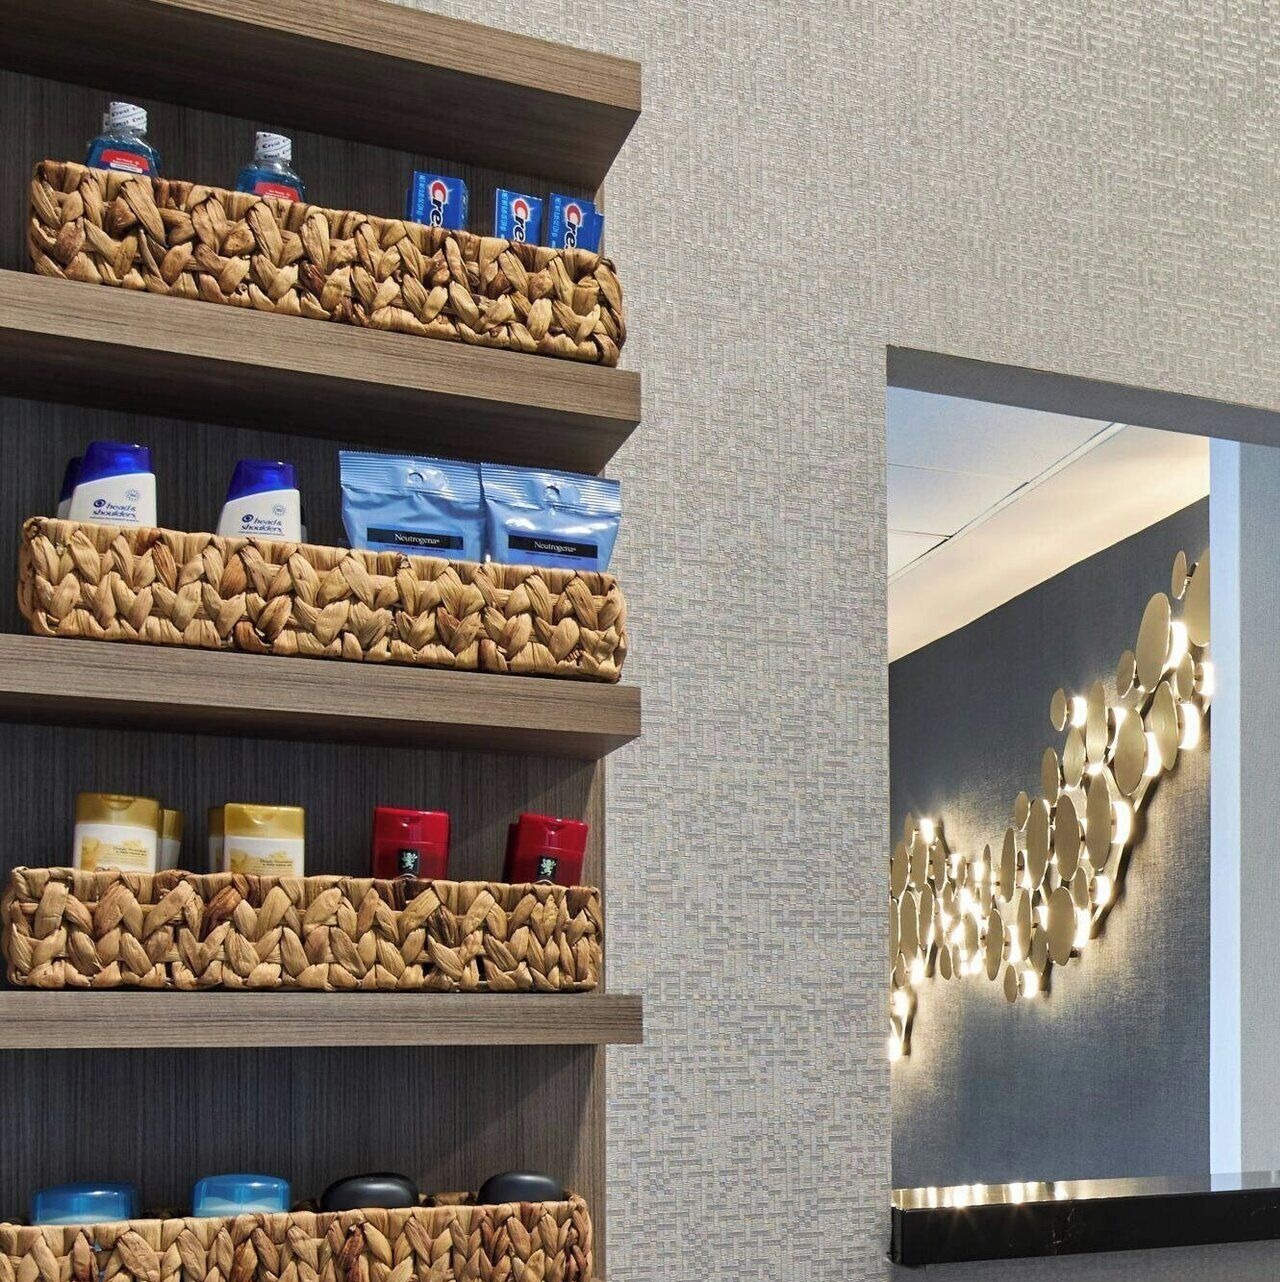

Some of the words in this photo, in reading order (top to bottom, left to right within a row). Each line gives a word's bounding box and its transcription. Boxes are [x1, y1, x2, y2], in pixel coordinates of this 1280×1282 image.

[431, 181, 447, 227] Cre
[513, 198, 529, 242] Cre
[565, 203, 583, 249] Cre
